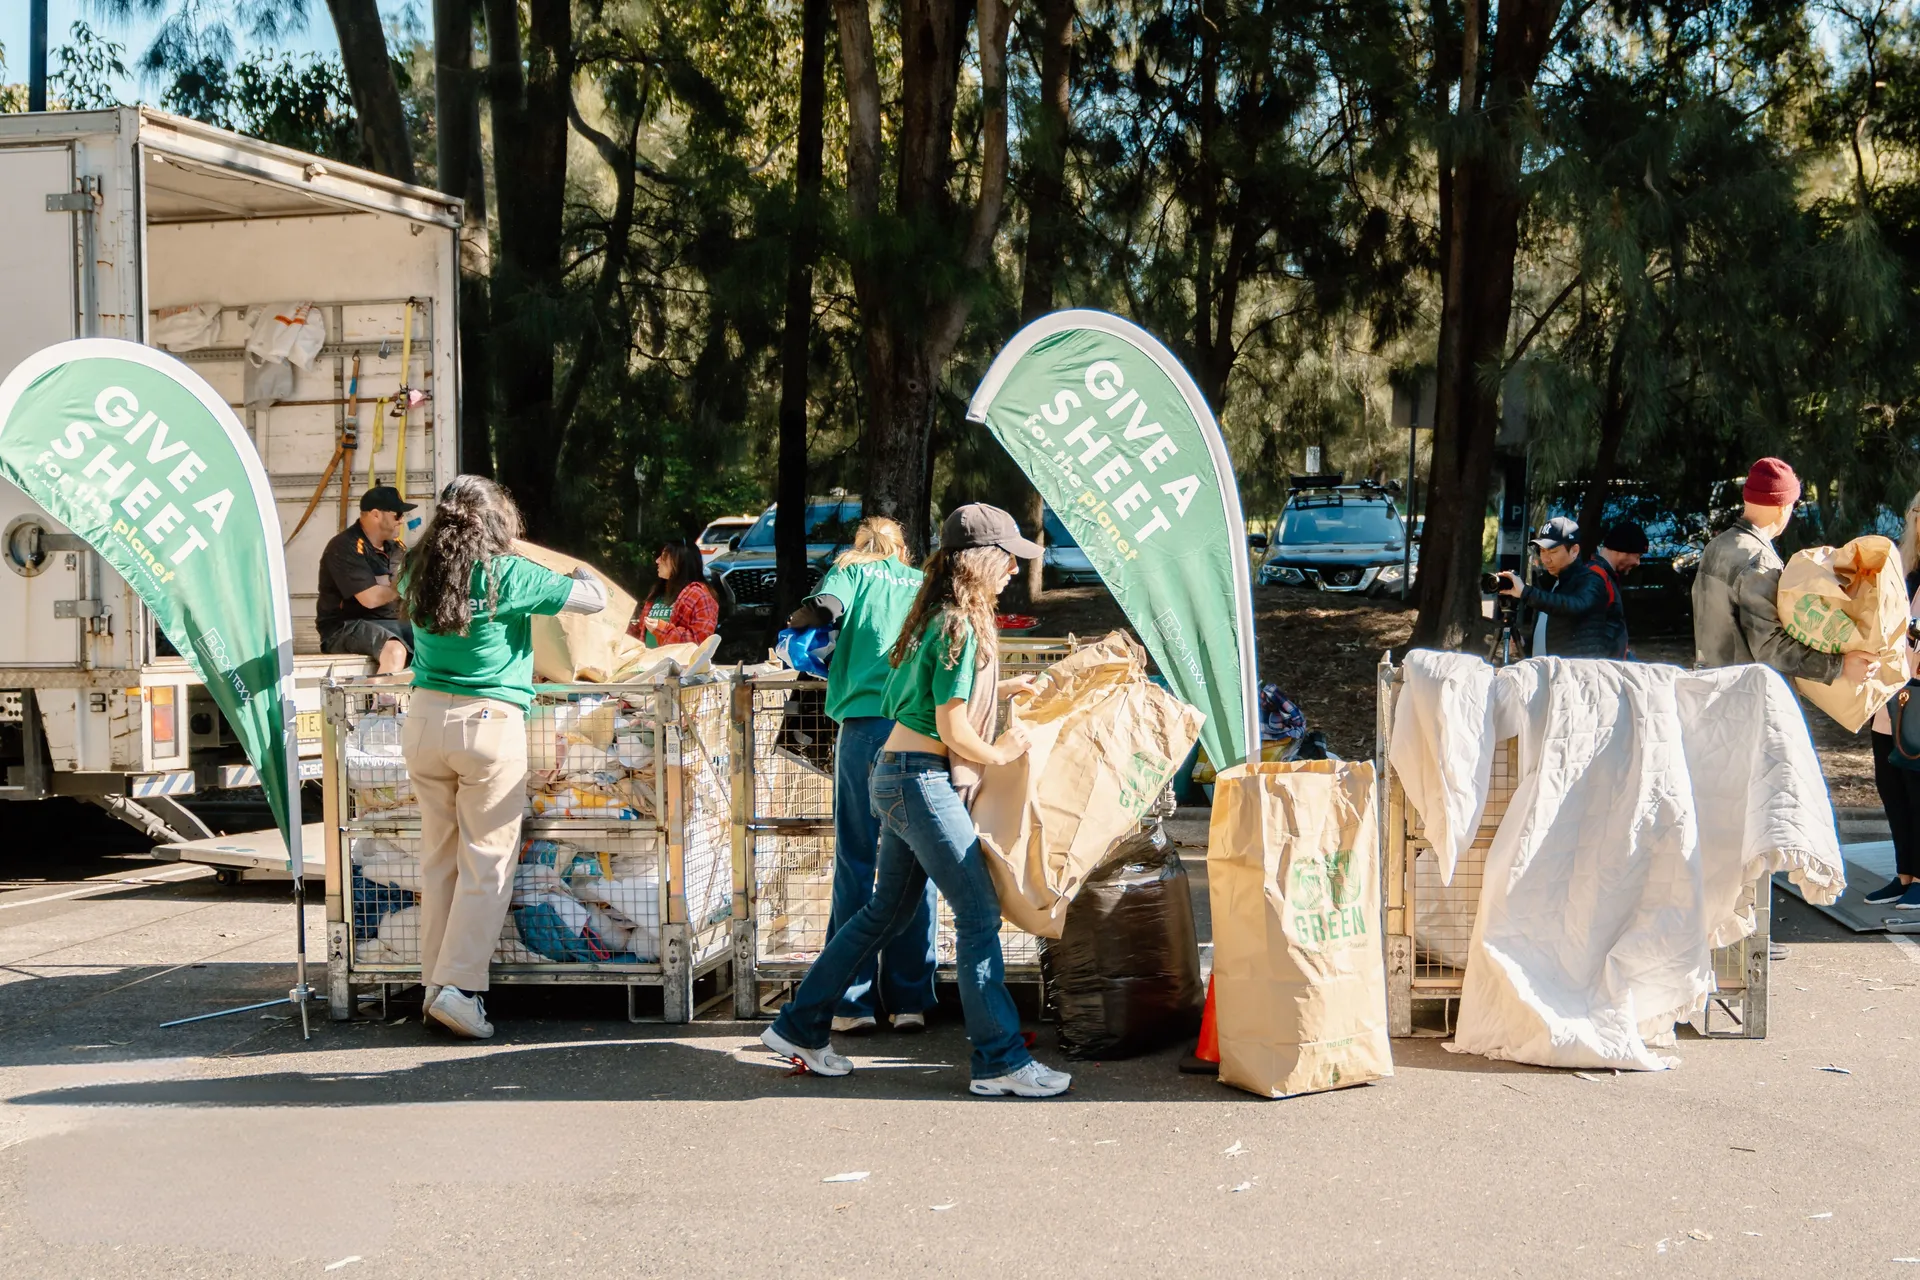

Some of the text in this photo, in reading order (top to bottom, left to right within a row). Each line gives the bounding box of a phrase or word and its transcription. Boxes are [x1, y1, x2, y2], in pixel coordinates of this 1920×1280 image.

[50, 422, 208, 565] SHEET
[94, 386, 207, 494] GIVE
[192, 488, 235, 534] A
[1023, 413, 1138, 561] for the planet
[1040, 389, 1171, 543] SHEET
[1084, 360, 1201, 518] GIVE A
[36, 450, 76, 490] for
[75, 482, 113, 518] the
[112, 518, 175, 585] planet
[1512, 505, 1522, 520] P
[204, 634, 233, 671] BLOCK
[232, 673, 253, 706] TEXX
[1161, 615, 1189, 656] BLOCK
[1188, 655, 1206, 689] TEXX
[1294, 905, 1367, 945] GREEN
